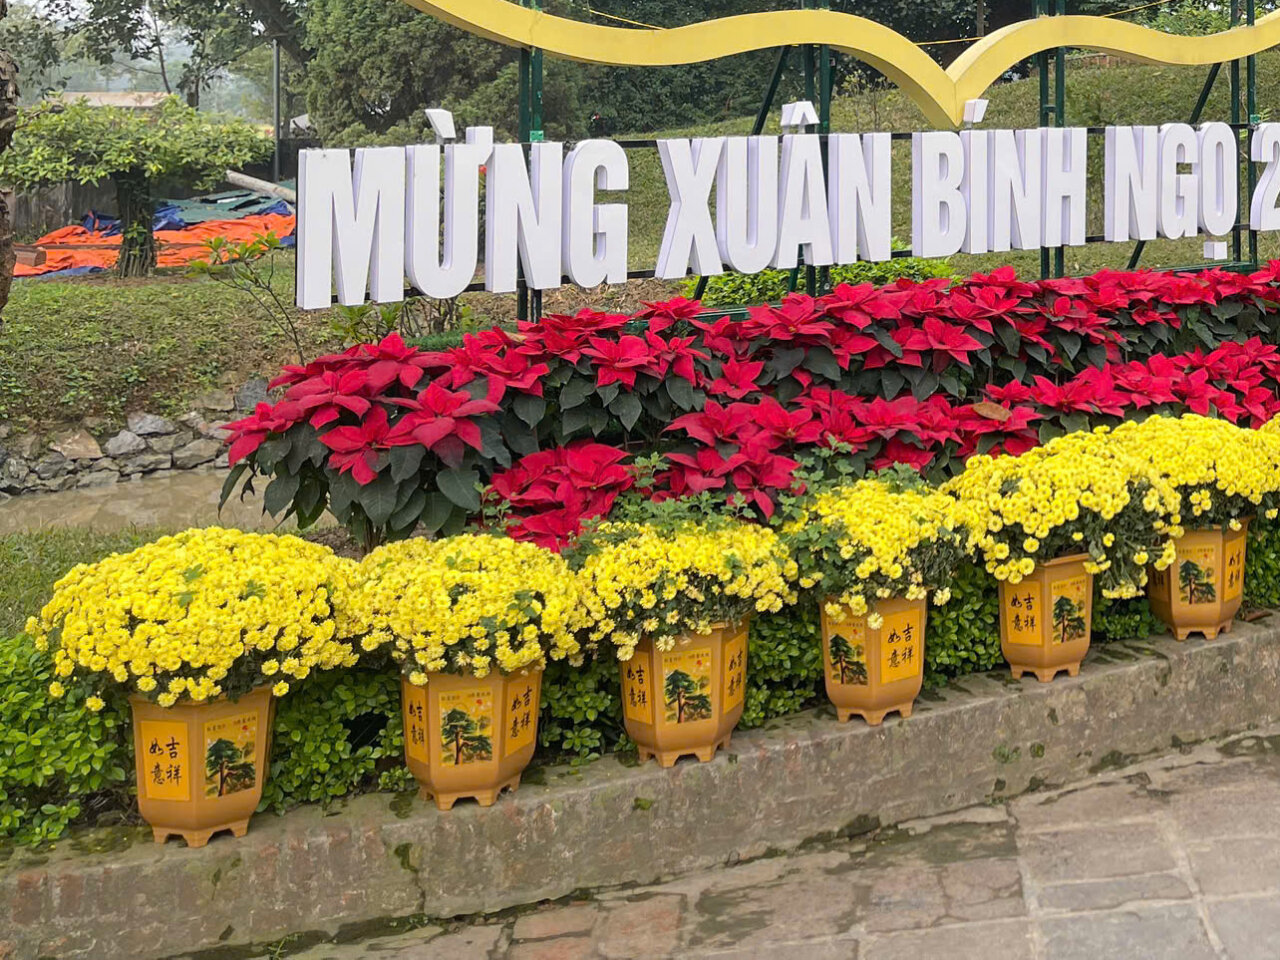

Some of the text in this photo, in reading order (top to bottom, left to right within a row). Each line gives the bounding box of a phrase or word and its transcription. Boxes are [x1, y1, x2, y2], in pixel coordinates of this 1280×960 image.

[297, 108, 629, 310] MỪNG
[655, 100, 892, 280] XUÂN
[912, 99, 1087, 258] BÍNH
[1105, 122, 1238, 260] NGỌ
